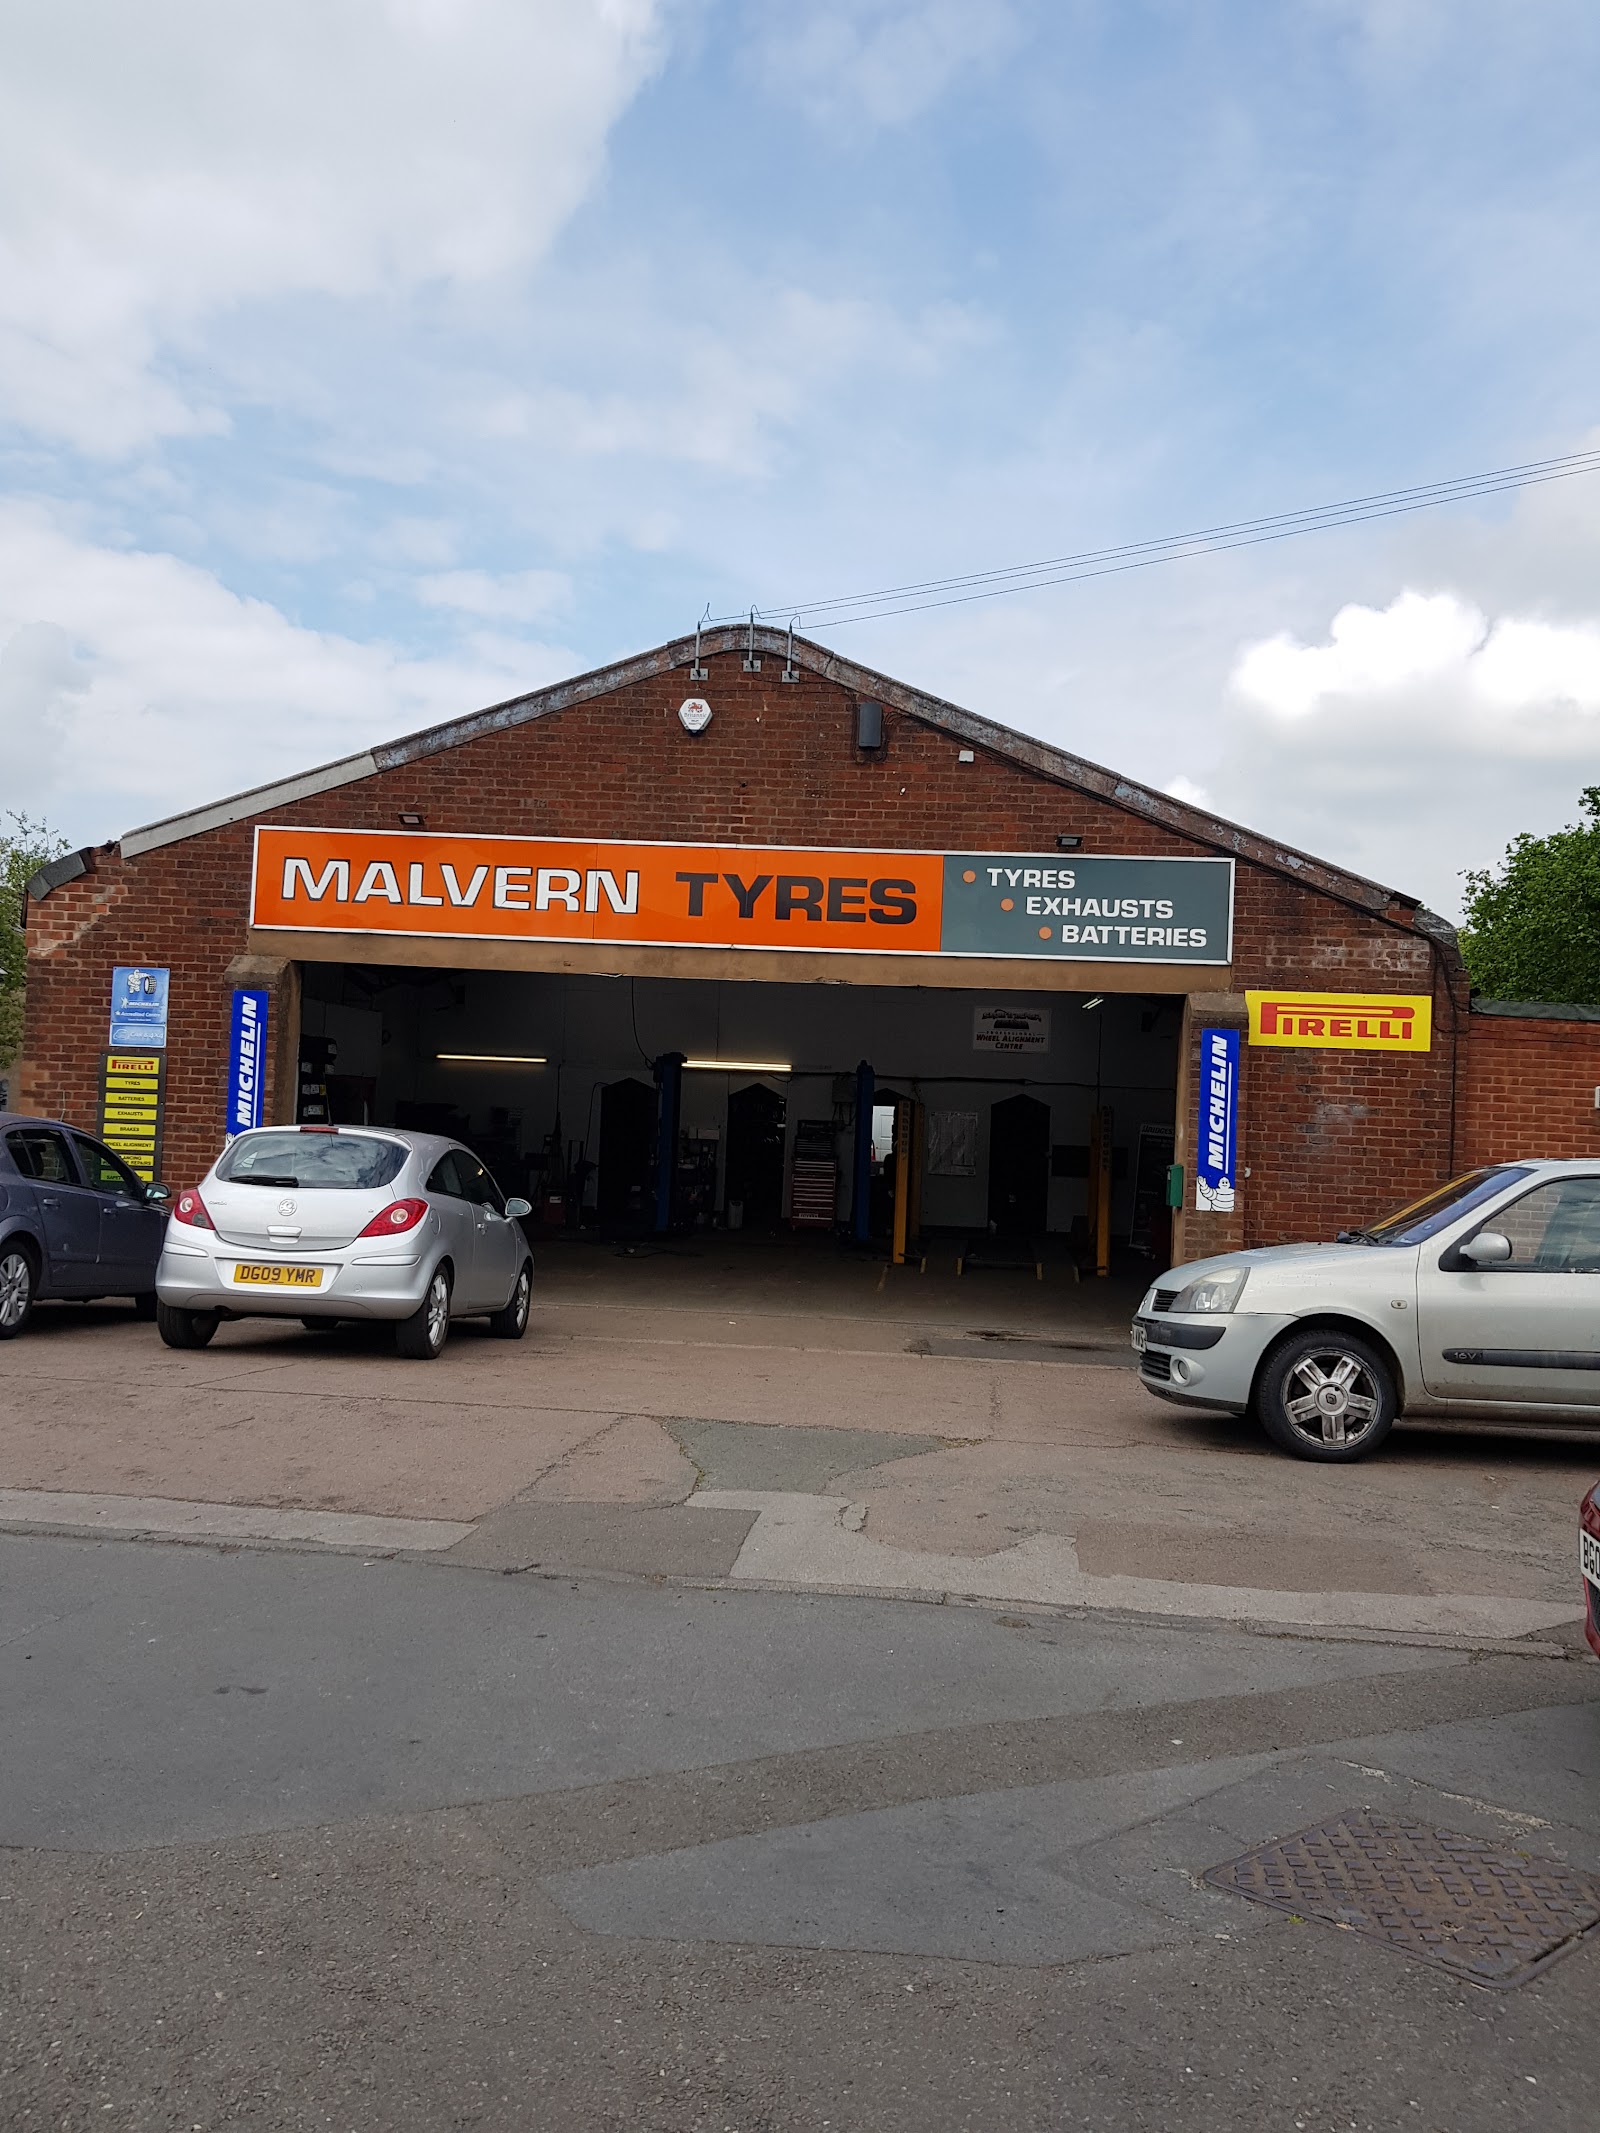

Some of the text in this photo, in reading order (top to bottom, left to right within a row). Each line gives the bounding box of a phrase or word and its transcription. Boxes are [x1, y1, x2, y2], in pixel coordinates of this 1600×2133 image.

[986, 867, 1076, 889] TYRES
[281, 855, 917, 925] MALVERN TYRES
[1026, 896, 1174, 919] EXHAUSTS
[1061, 925, 1207, 948] BATTERIES
[1260, 1001, 1416, 1040] PIRELLI
[976, 1034, 1046, 1043] WHEEL ALIGNMENT
[995, 1042, 1024, 1050] CENTRE
[111, 1059, 154, 1071] PIRELLI
[237, 995, 258, 1128] MICHELIN
[1208, 1034, 1228, 1171] MICHELIN
[1142, 1124, 1174, 1135] BRIDGES
[240, 1265, 316, 1283] DG09 YMR
[1454, 1352, 1477, 1360] 16V
